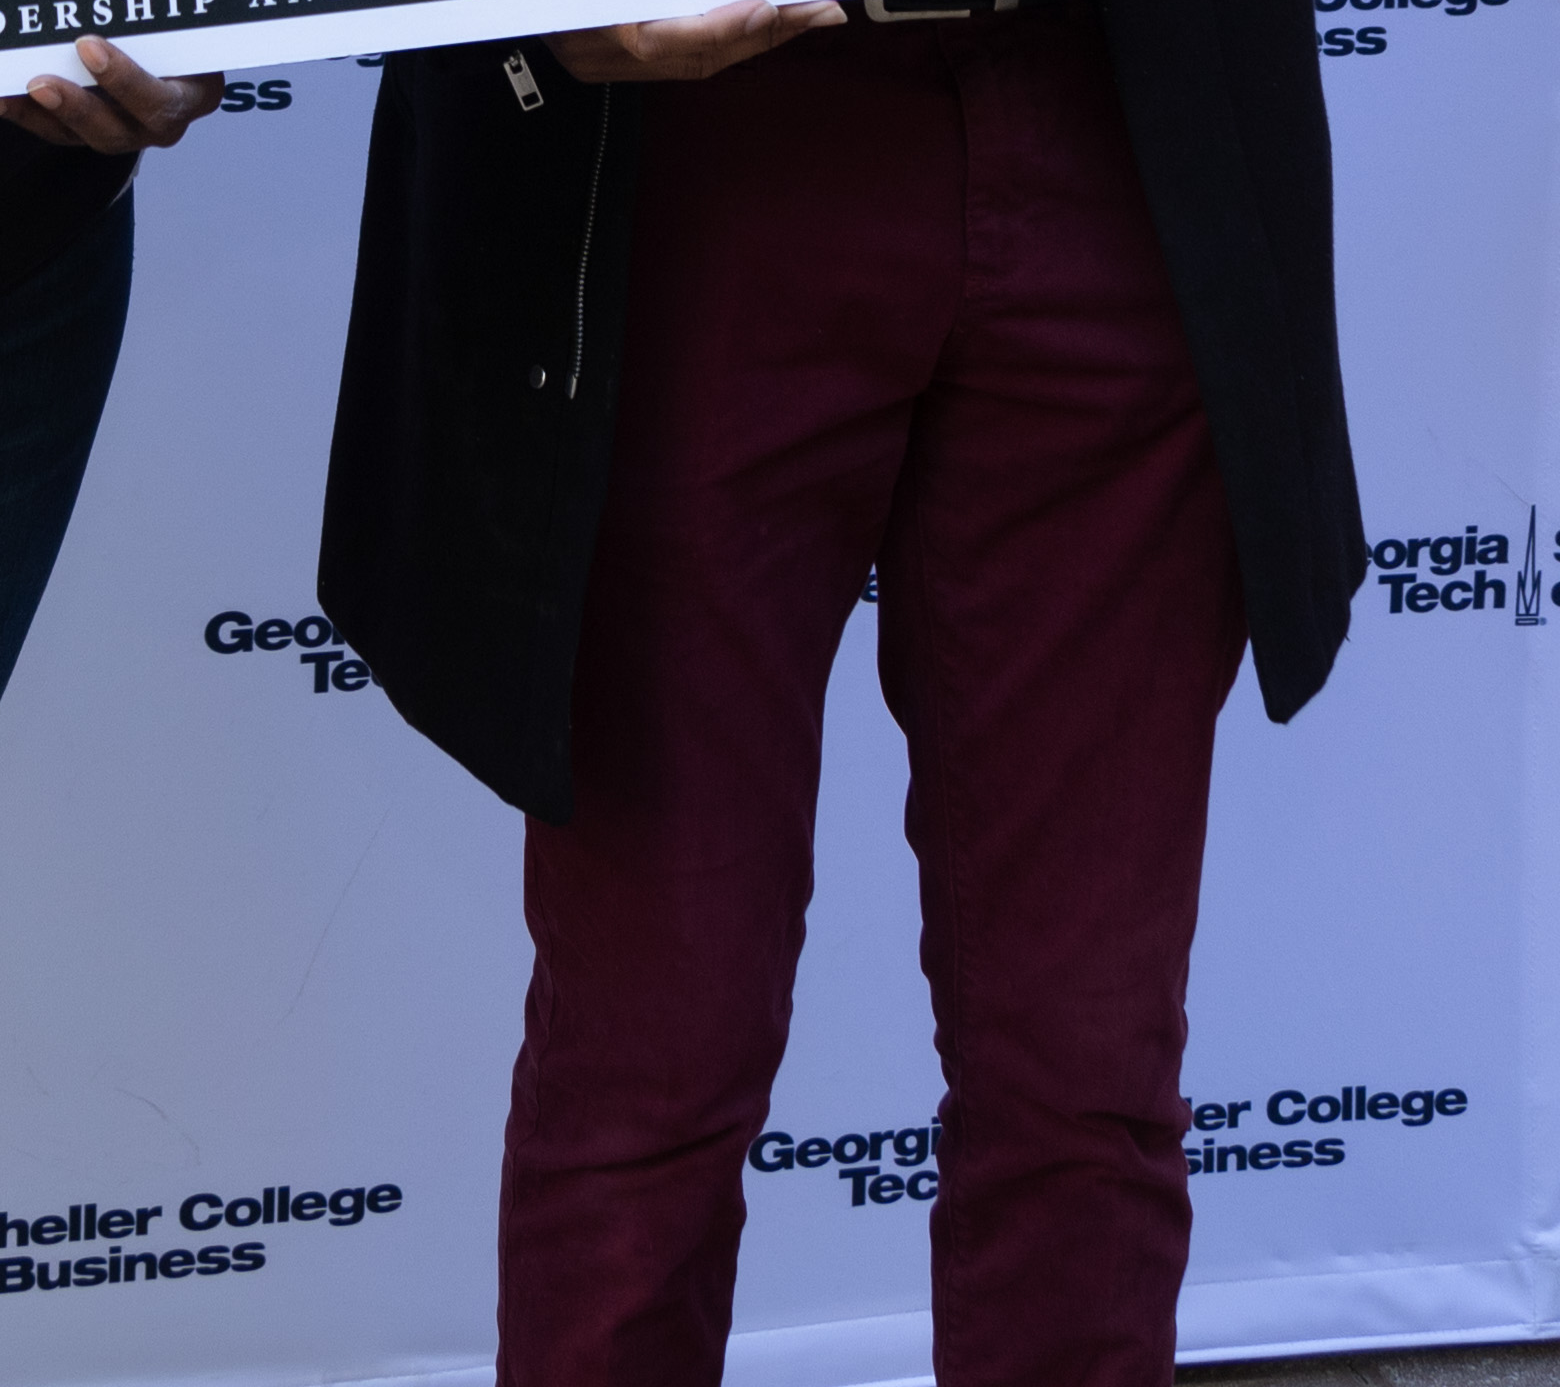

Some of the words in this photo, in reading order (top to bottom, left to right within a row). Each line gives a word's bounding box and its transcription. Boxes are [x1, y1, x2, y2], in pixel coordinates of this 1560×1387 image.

[1367, 525, 1509, 575] orgia
[1378, 570, 1506, 613] Tech
[300, 651, 382, 694] Te
[1267, 1086, 1467, 1126] College
[180, 1184, 402, 1231] College
